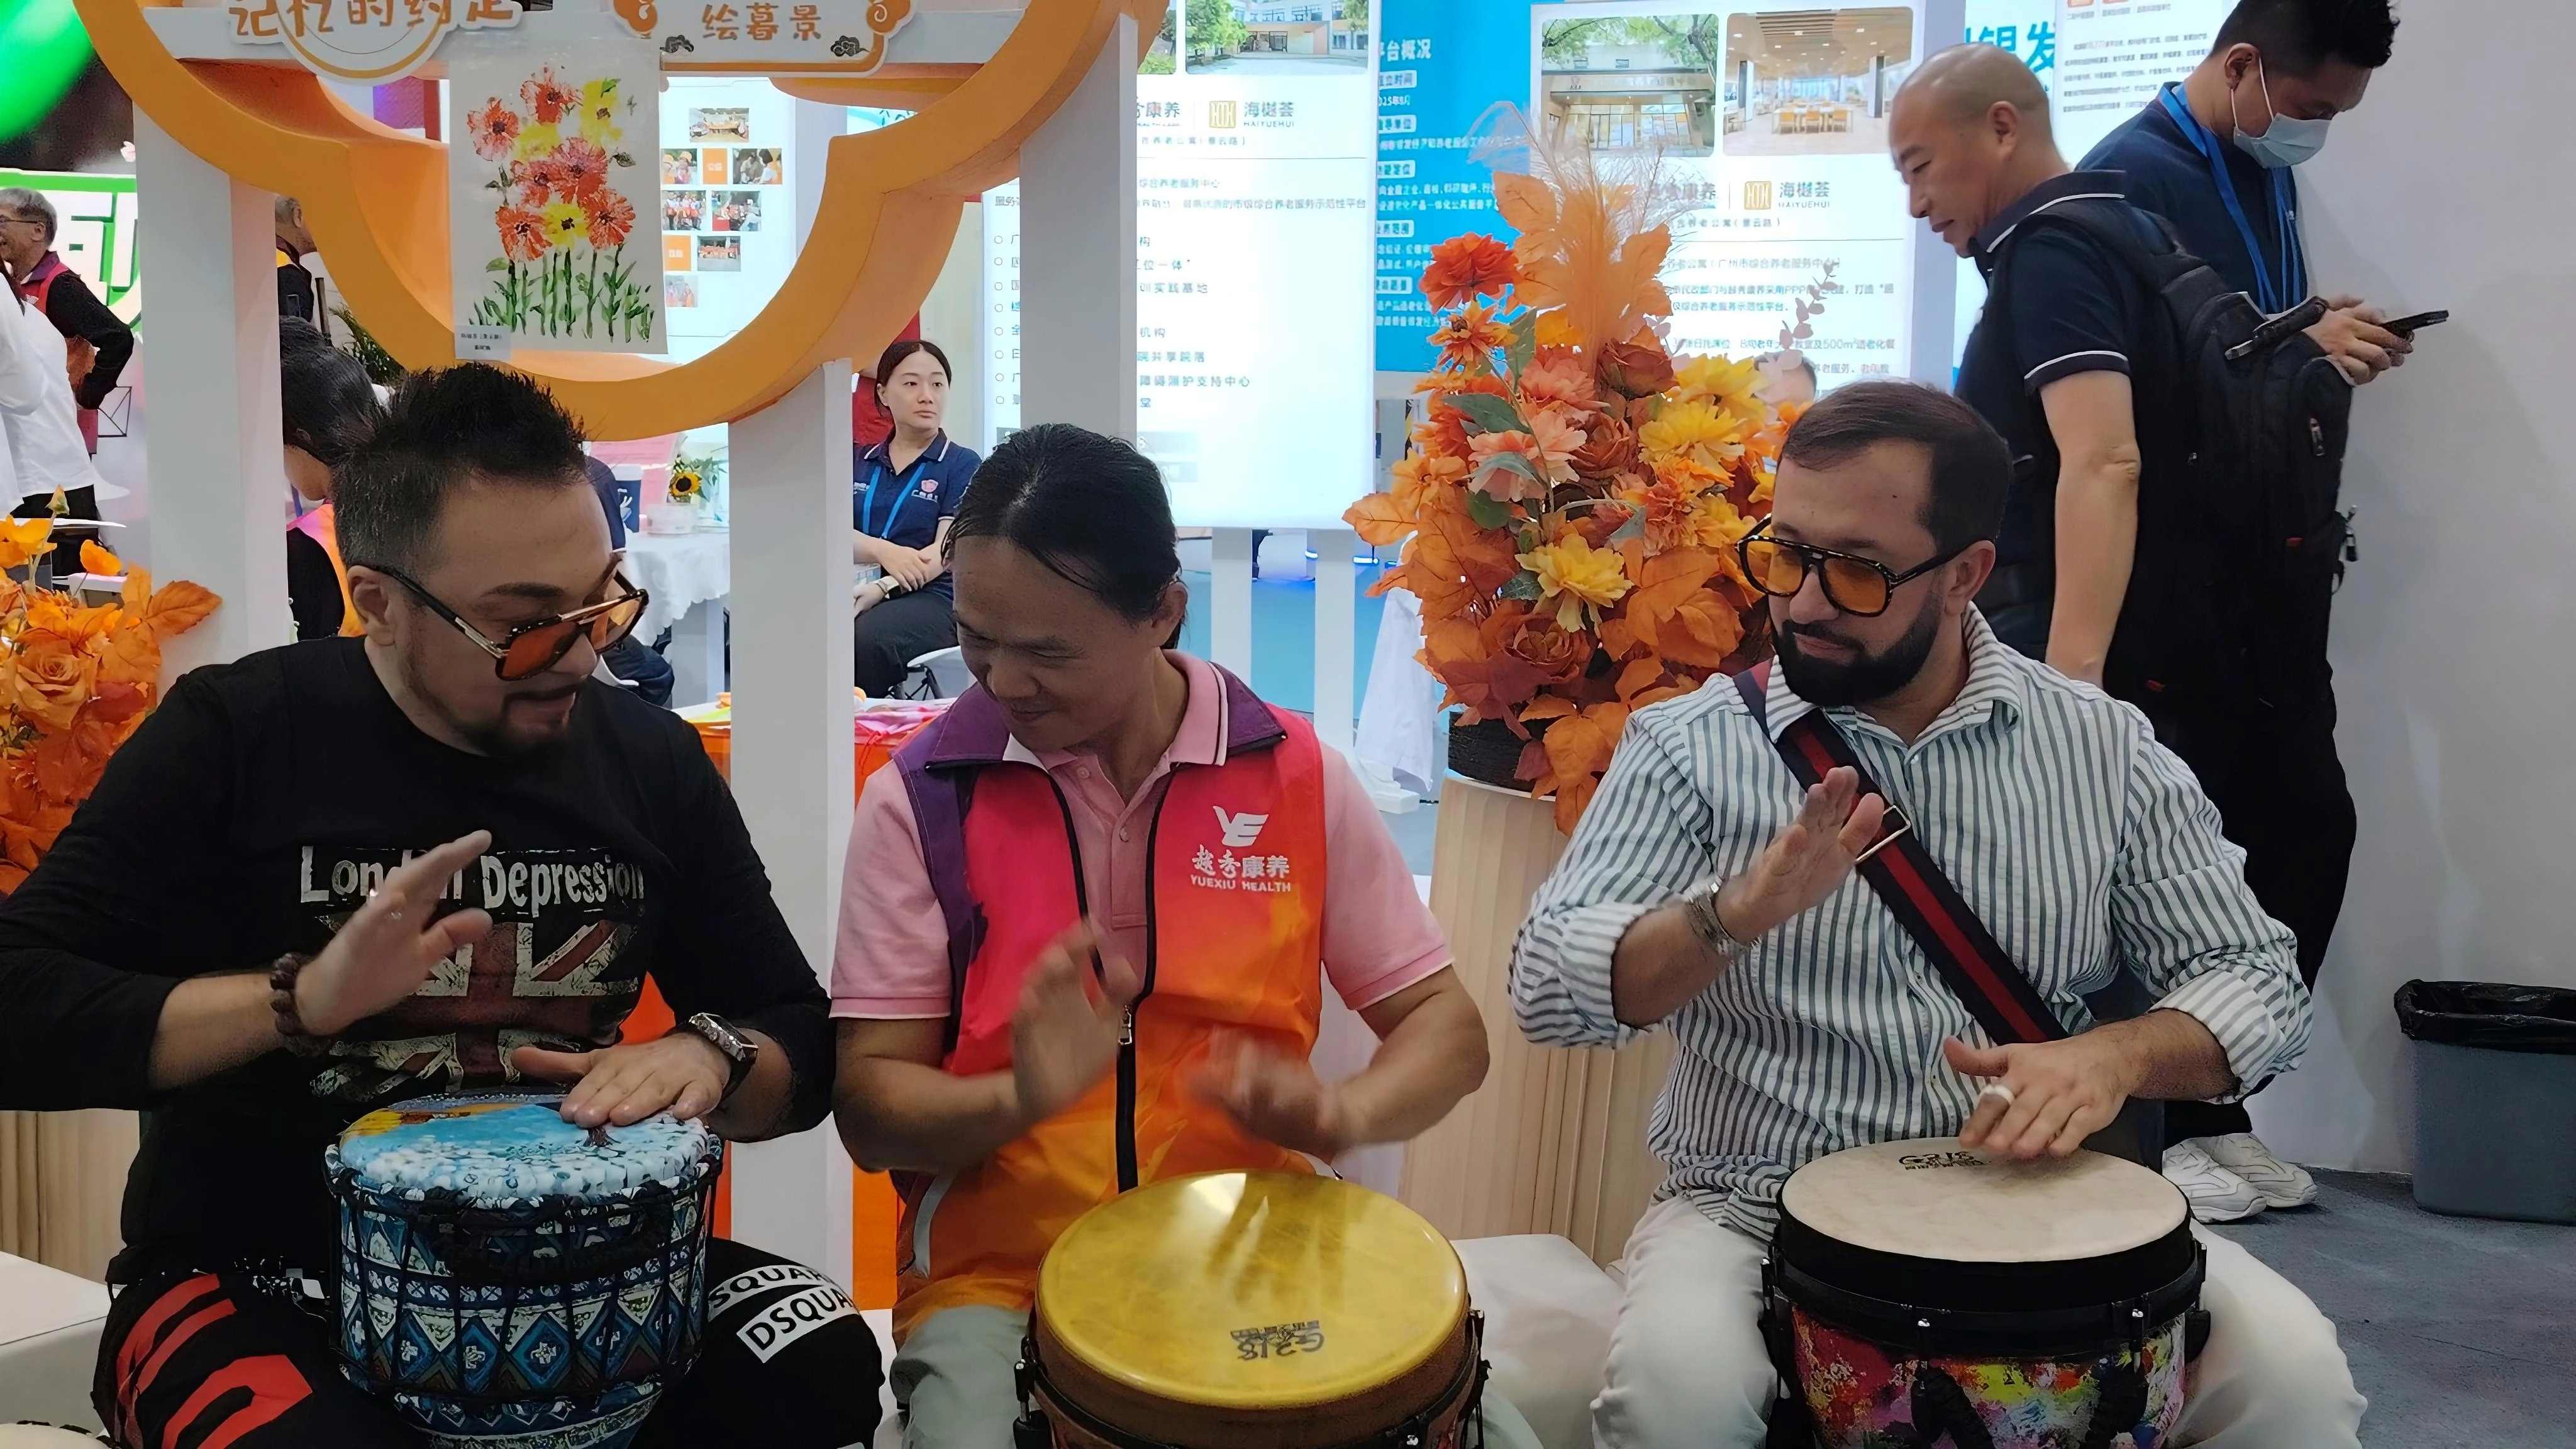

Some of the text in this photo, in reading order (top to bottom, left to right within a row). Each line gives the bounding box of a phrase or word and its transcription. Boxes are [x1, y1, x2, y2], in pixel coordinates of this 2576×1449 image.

[1192, 844, 1290, 879] 越秀康养
[480, 855, 645, 918] Depression
[1191, 874, 1291, 892] YUEXIU HEALTH
